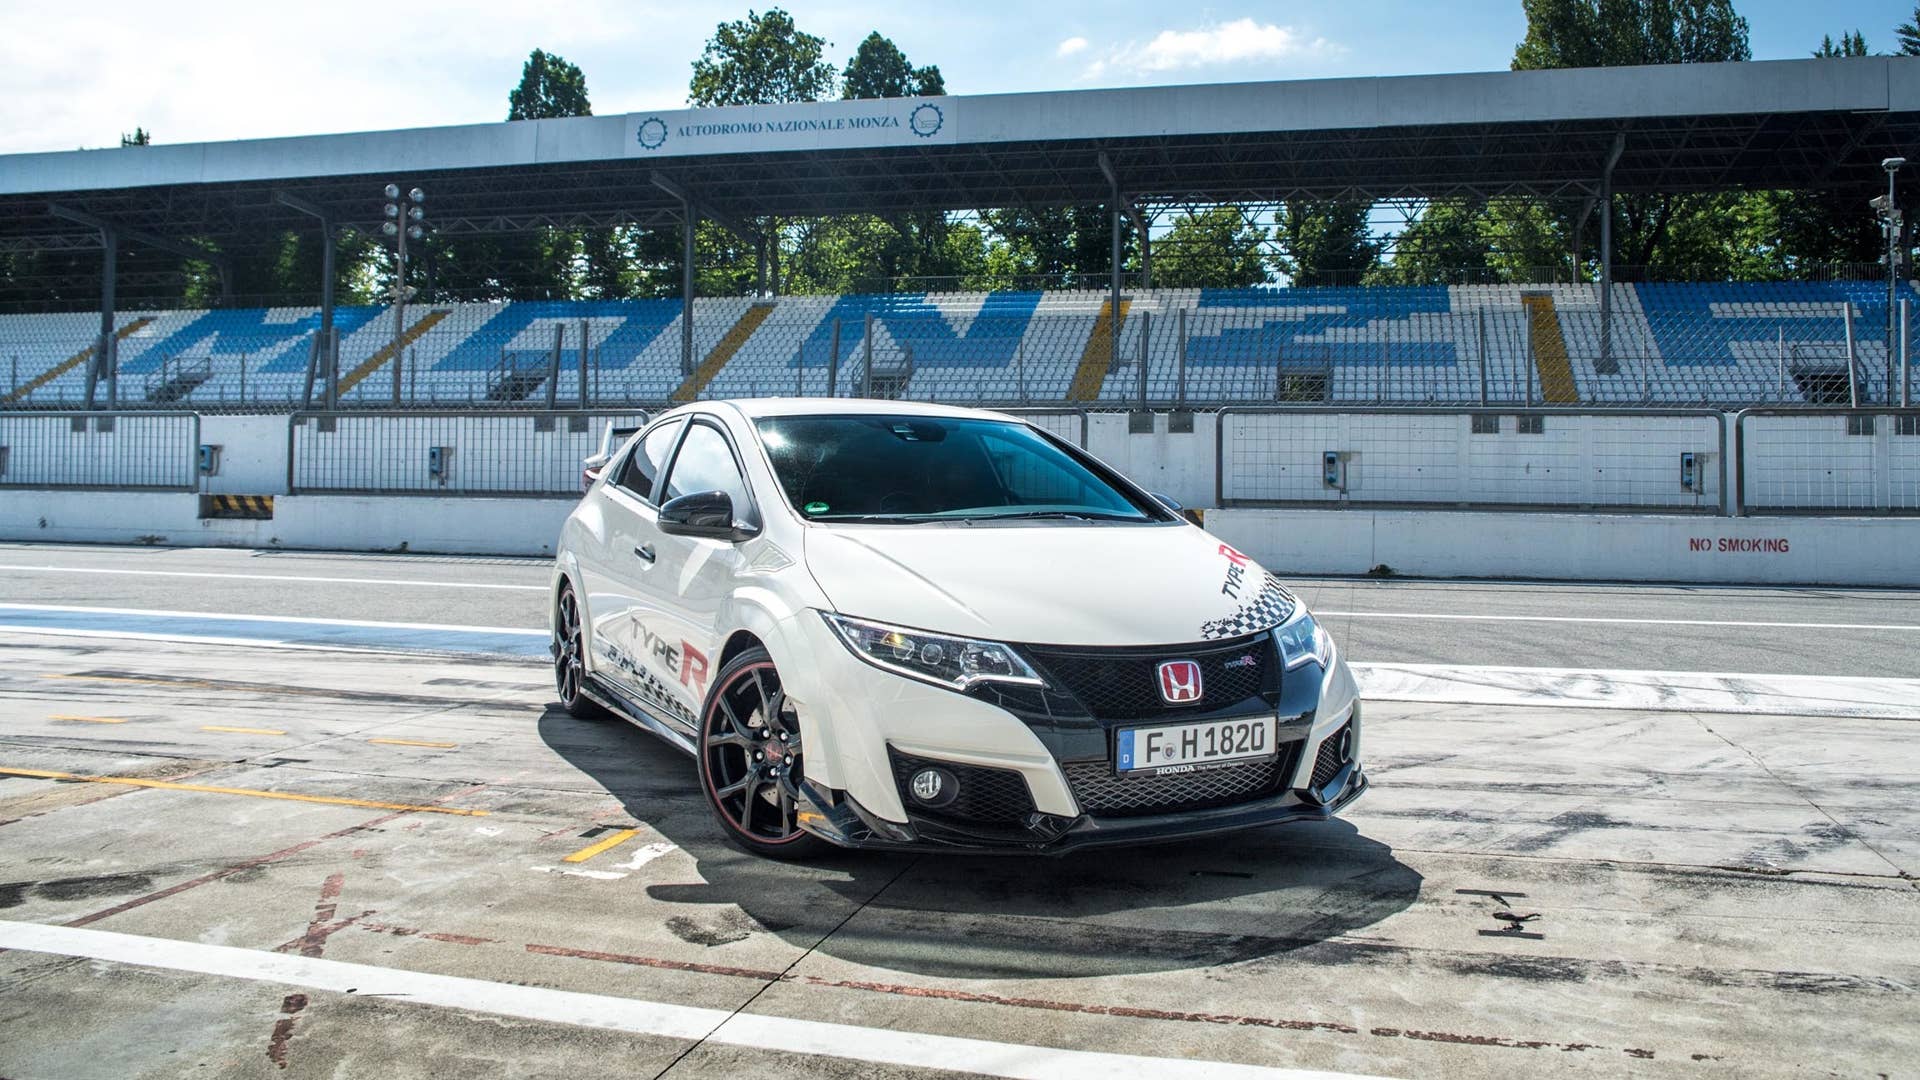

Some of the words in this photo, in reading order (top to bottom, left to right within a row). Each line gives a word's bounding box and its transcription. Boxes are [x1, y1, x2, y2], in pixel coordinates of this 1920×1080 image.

[676, 121, 763, 138] AUTODROMO
[765, 118, 845, 134] NAZIONALE
[848, 115, 900, 130] MONZA
[1689, 537, 1712, 552] NO
[1718, 537, 1790, 553] SMOKING
[1156, 765, 1196, 775] HONDA
